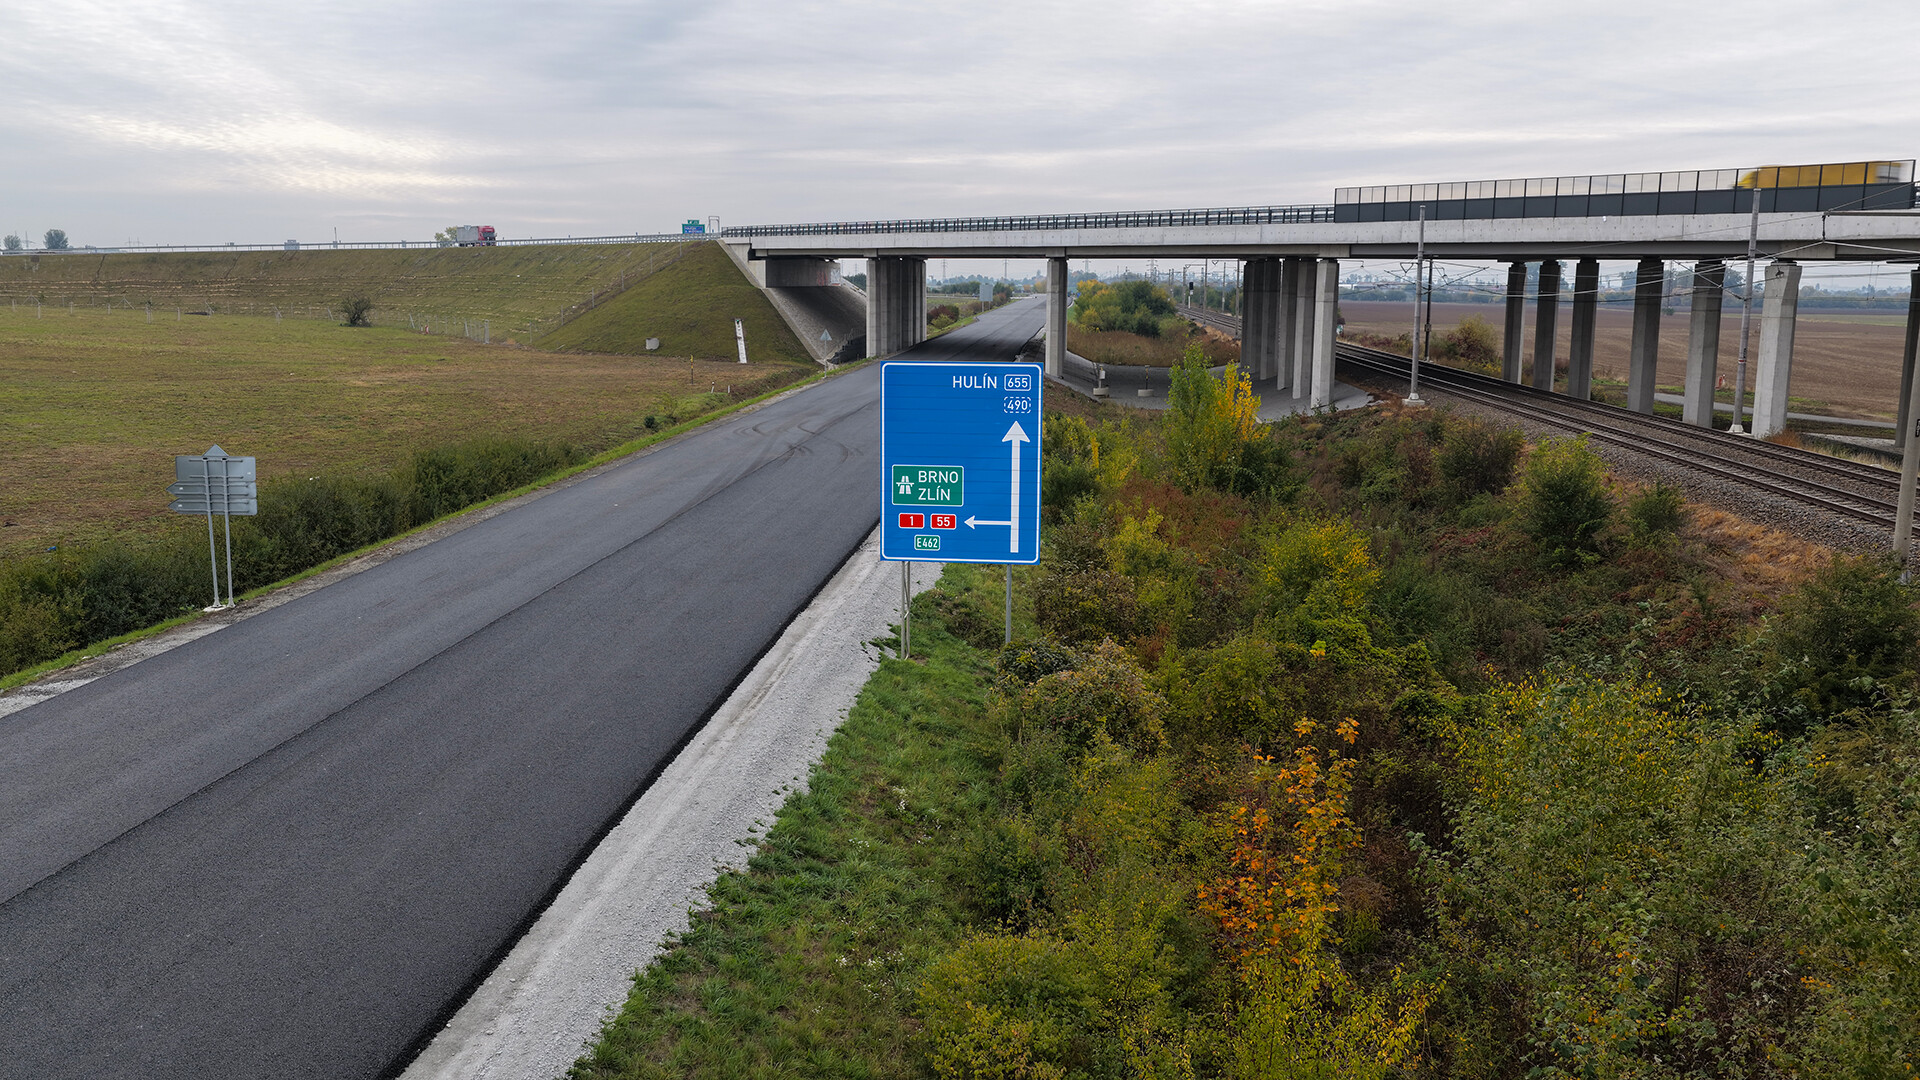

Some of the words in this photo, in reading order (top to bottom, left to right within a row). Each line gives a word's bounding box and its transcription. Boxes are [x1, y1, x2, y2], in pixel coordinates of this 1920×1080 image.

[953, 373, 997, 389] HULÍN
[1007, 378, 1028, 388] 655
[1007, 400, 1028, 411] 490
[918, 471, 959, 483] BRNO
[918, 485, 951, 501] ZLÍN
[909, 516, 915, 526] 1
[936, 516, 951, 527] 55
